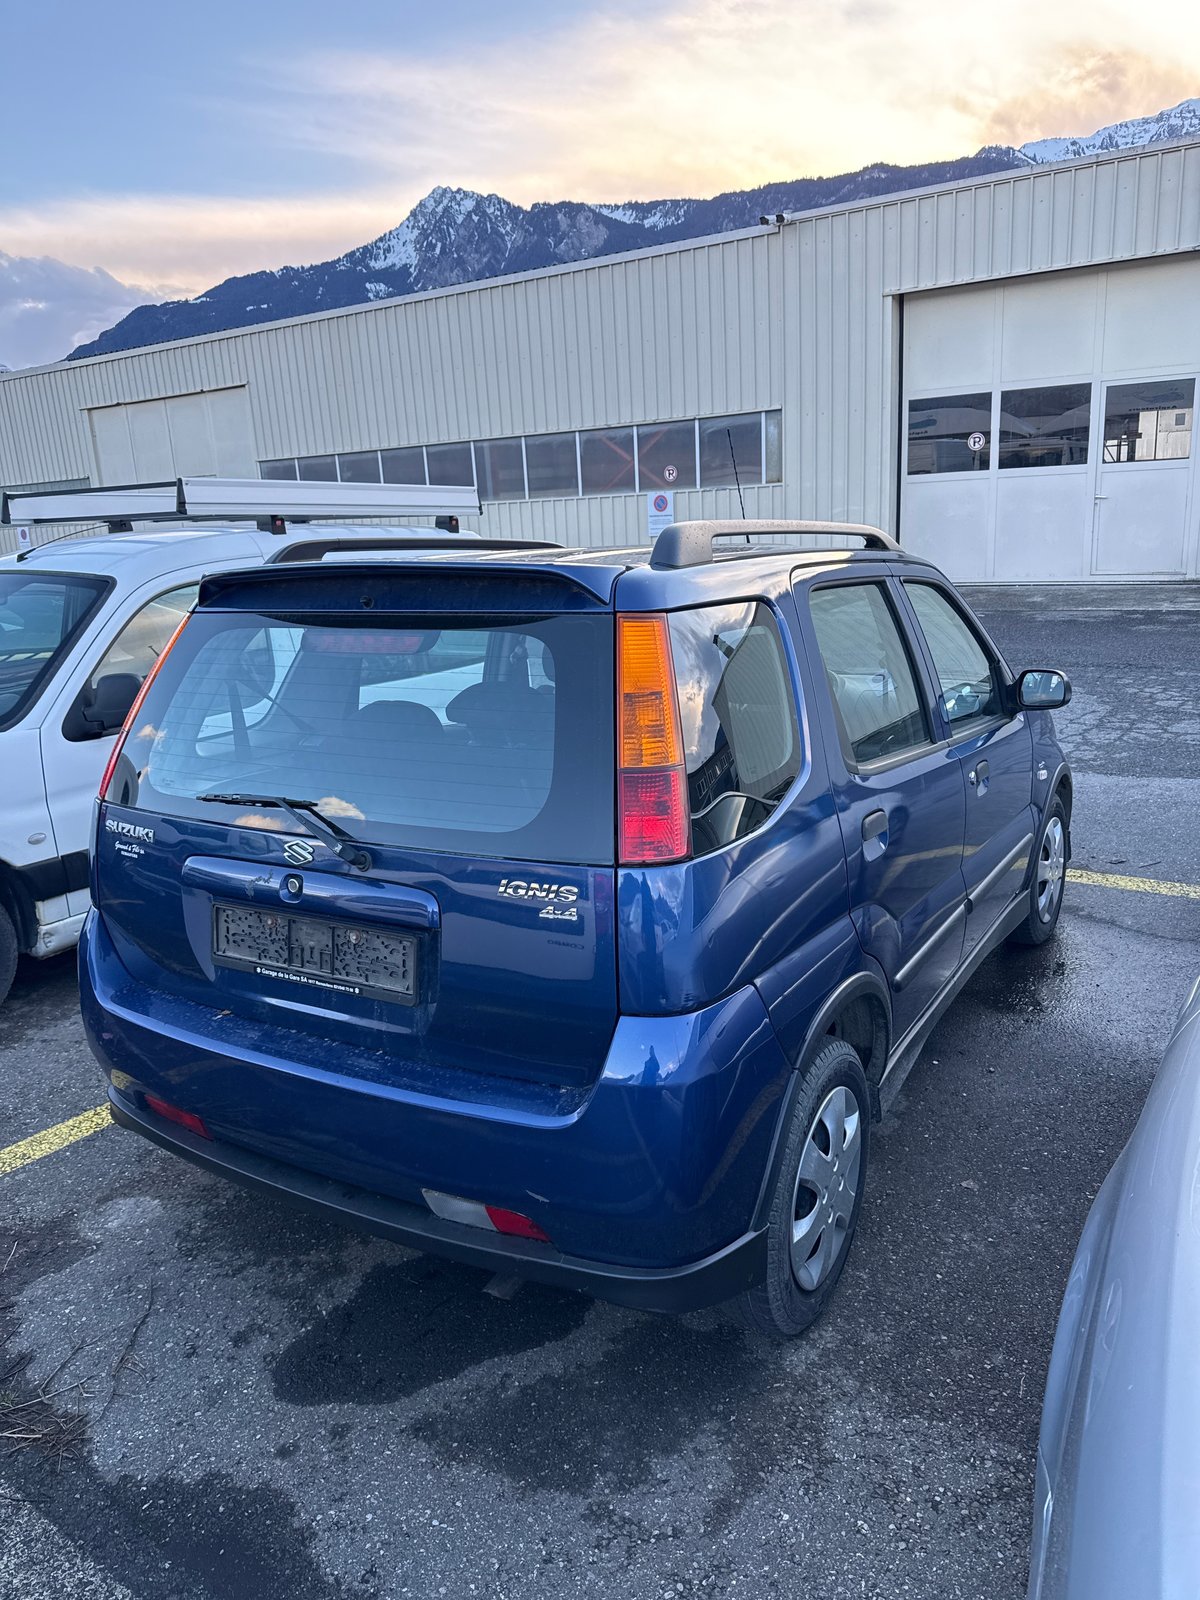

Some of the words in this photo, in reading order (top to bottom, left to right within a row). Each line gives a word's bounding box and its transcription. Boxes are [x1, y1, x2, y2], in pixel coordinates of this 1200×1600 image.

[105, 819, 154, 843] SUZUKI
[497, 879, 579, 904] IGNIS
[261, 967, 278, 977] Garage
[278, 970, 284, 978] de
[289, 973, 300, 982] Gare
[300, 975, 307, 983] SA
